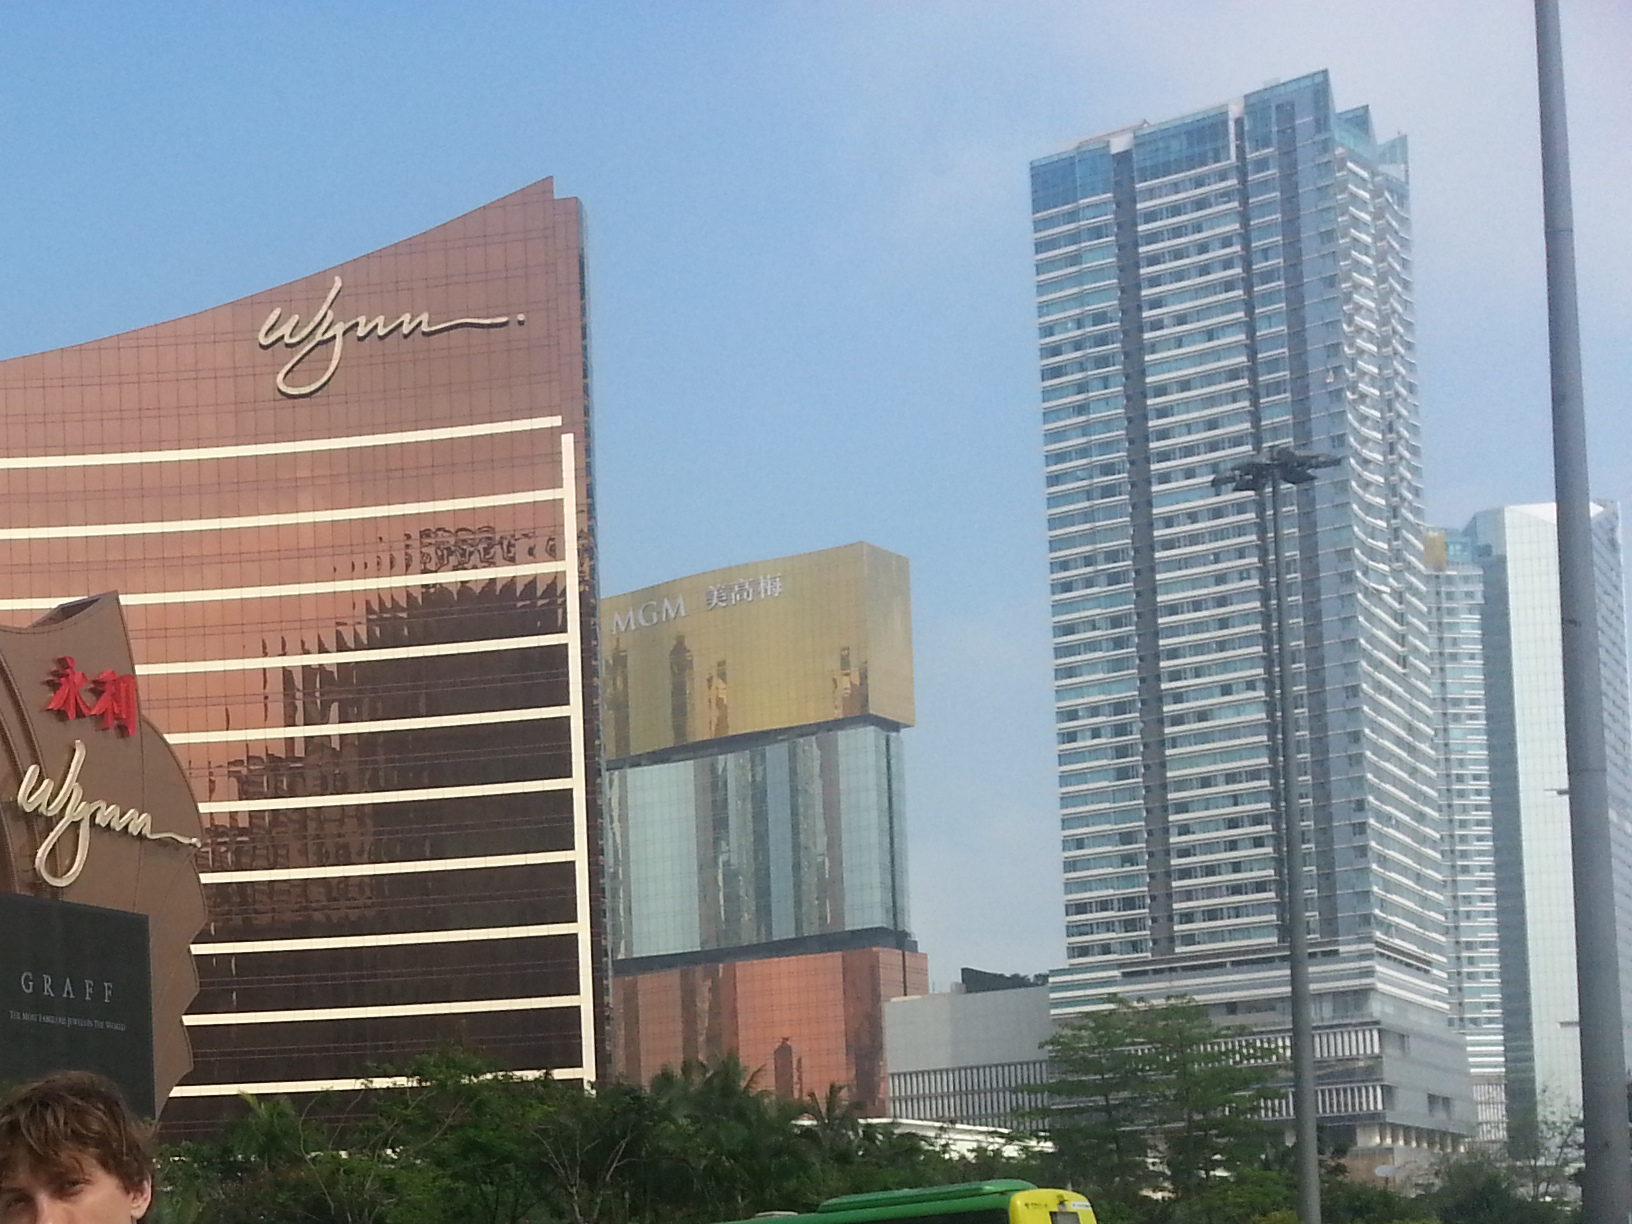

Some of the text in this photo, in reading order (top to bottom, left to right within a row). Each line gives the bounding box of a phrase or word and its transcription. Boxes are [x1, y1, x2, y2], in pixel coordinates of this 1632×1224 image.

[611, 573, 783, 635] MGM 美高梅
[47, 655, 137, 736] 永利
[21, 971, 113, 1003] GRAFF
